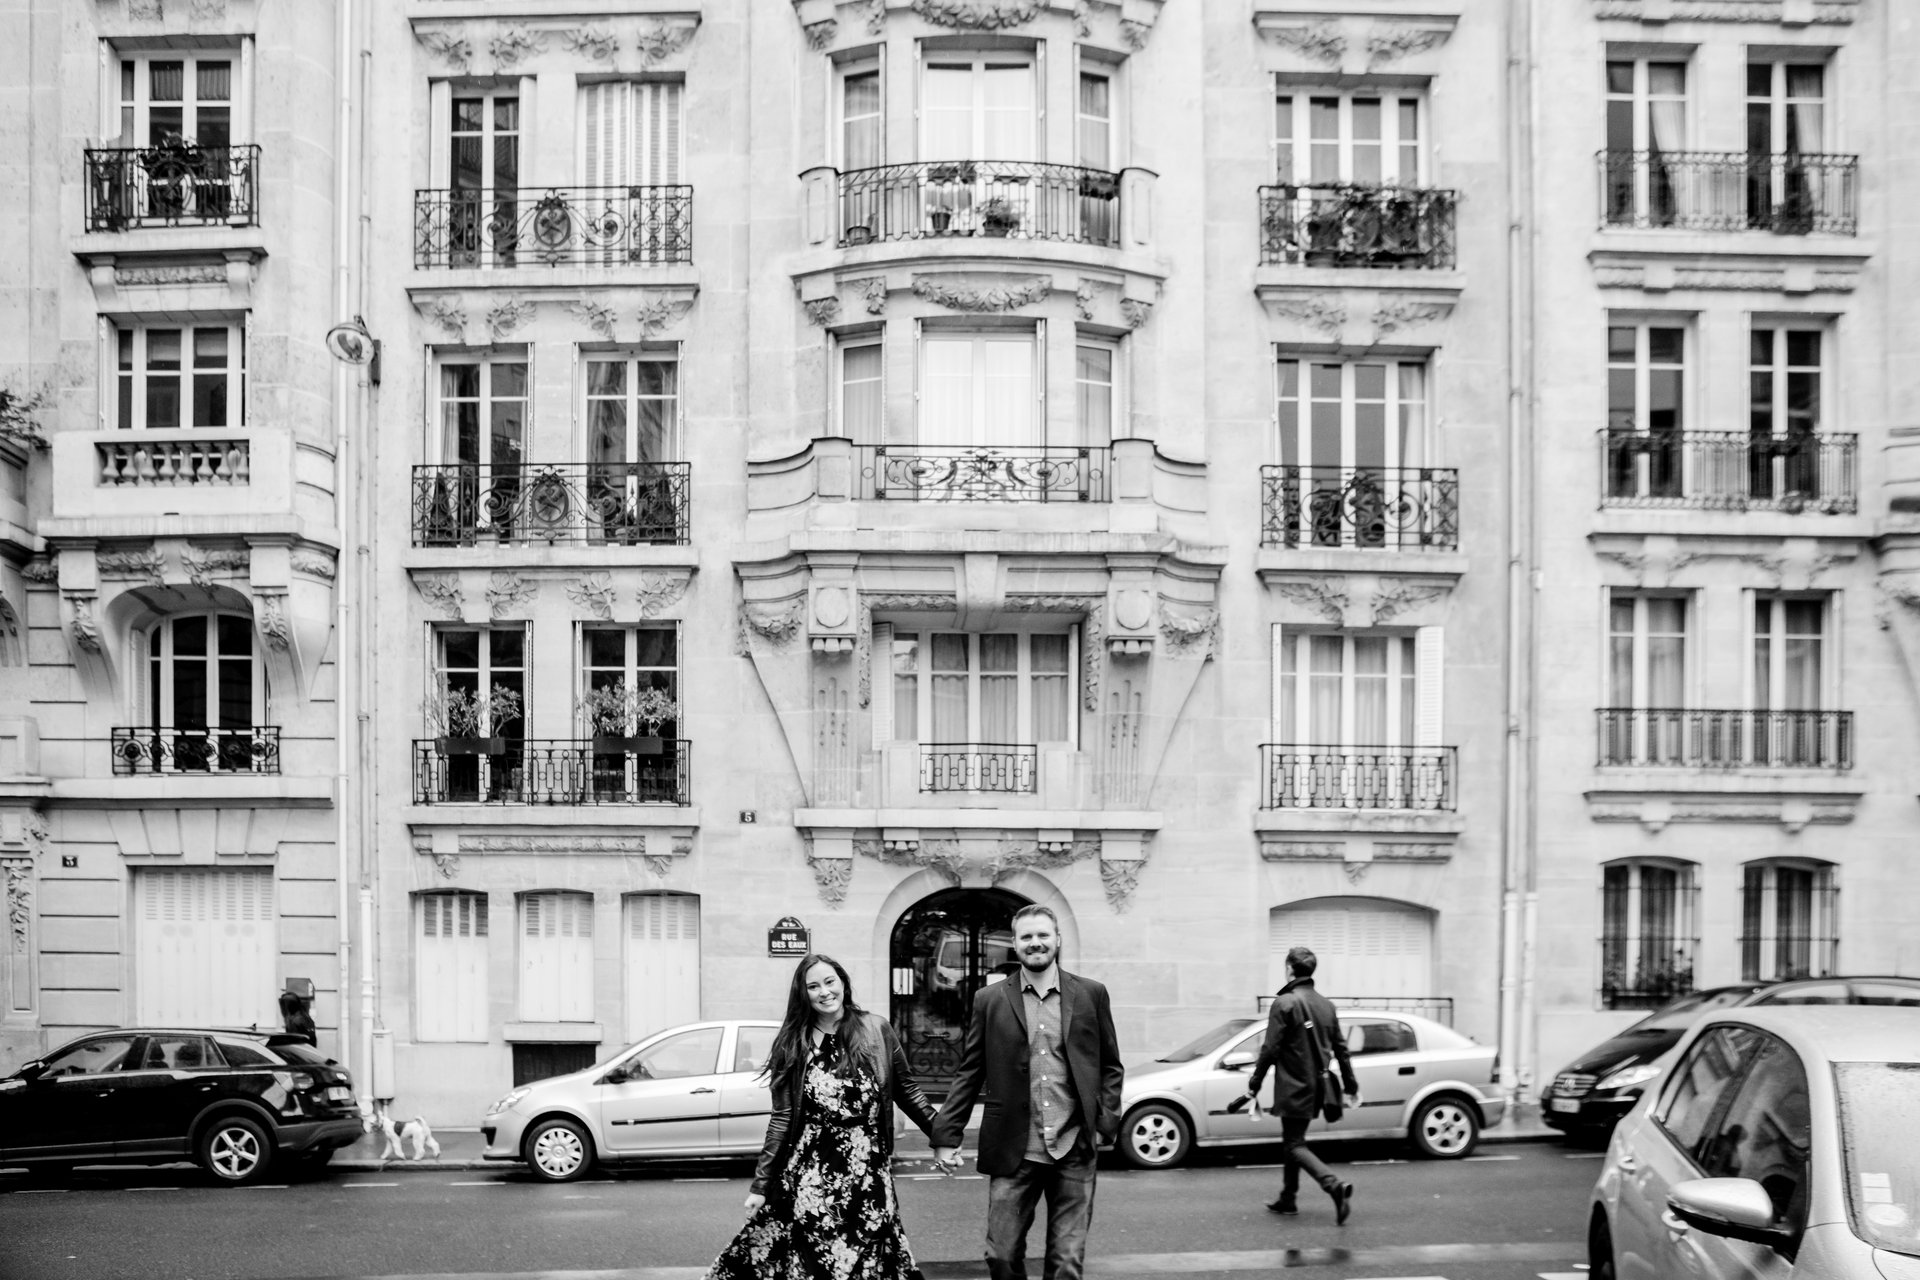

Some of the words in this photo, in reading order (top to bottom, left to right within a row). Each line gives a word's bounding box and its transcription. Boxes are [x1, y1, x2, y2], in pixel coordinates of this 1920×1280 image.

[744, 812, 752, 822] 5
[781, 933, 797, 941] RUE
[771, 941, 786, 949] DES
[787, 941, 807, 949] EAUX
